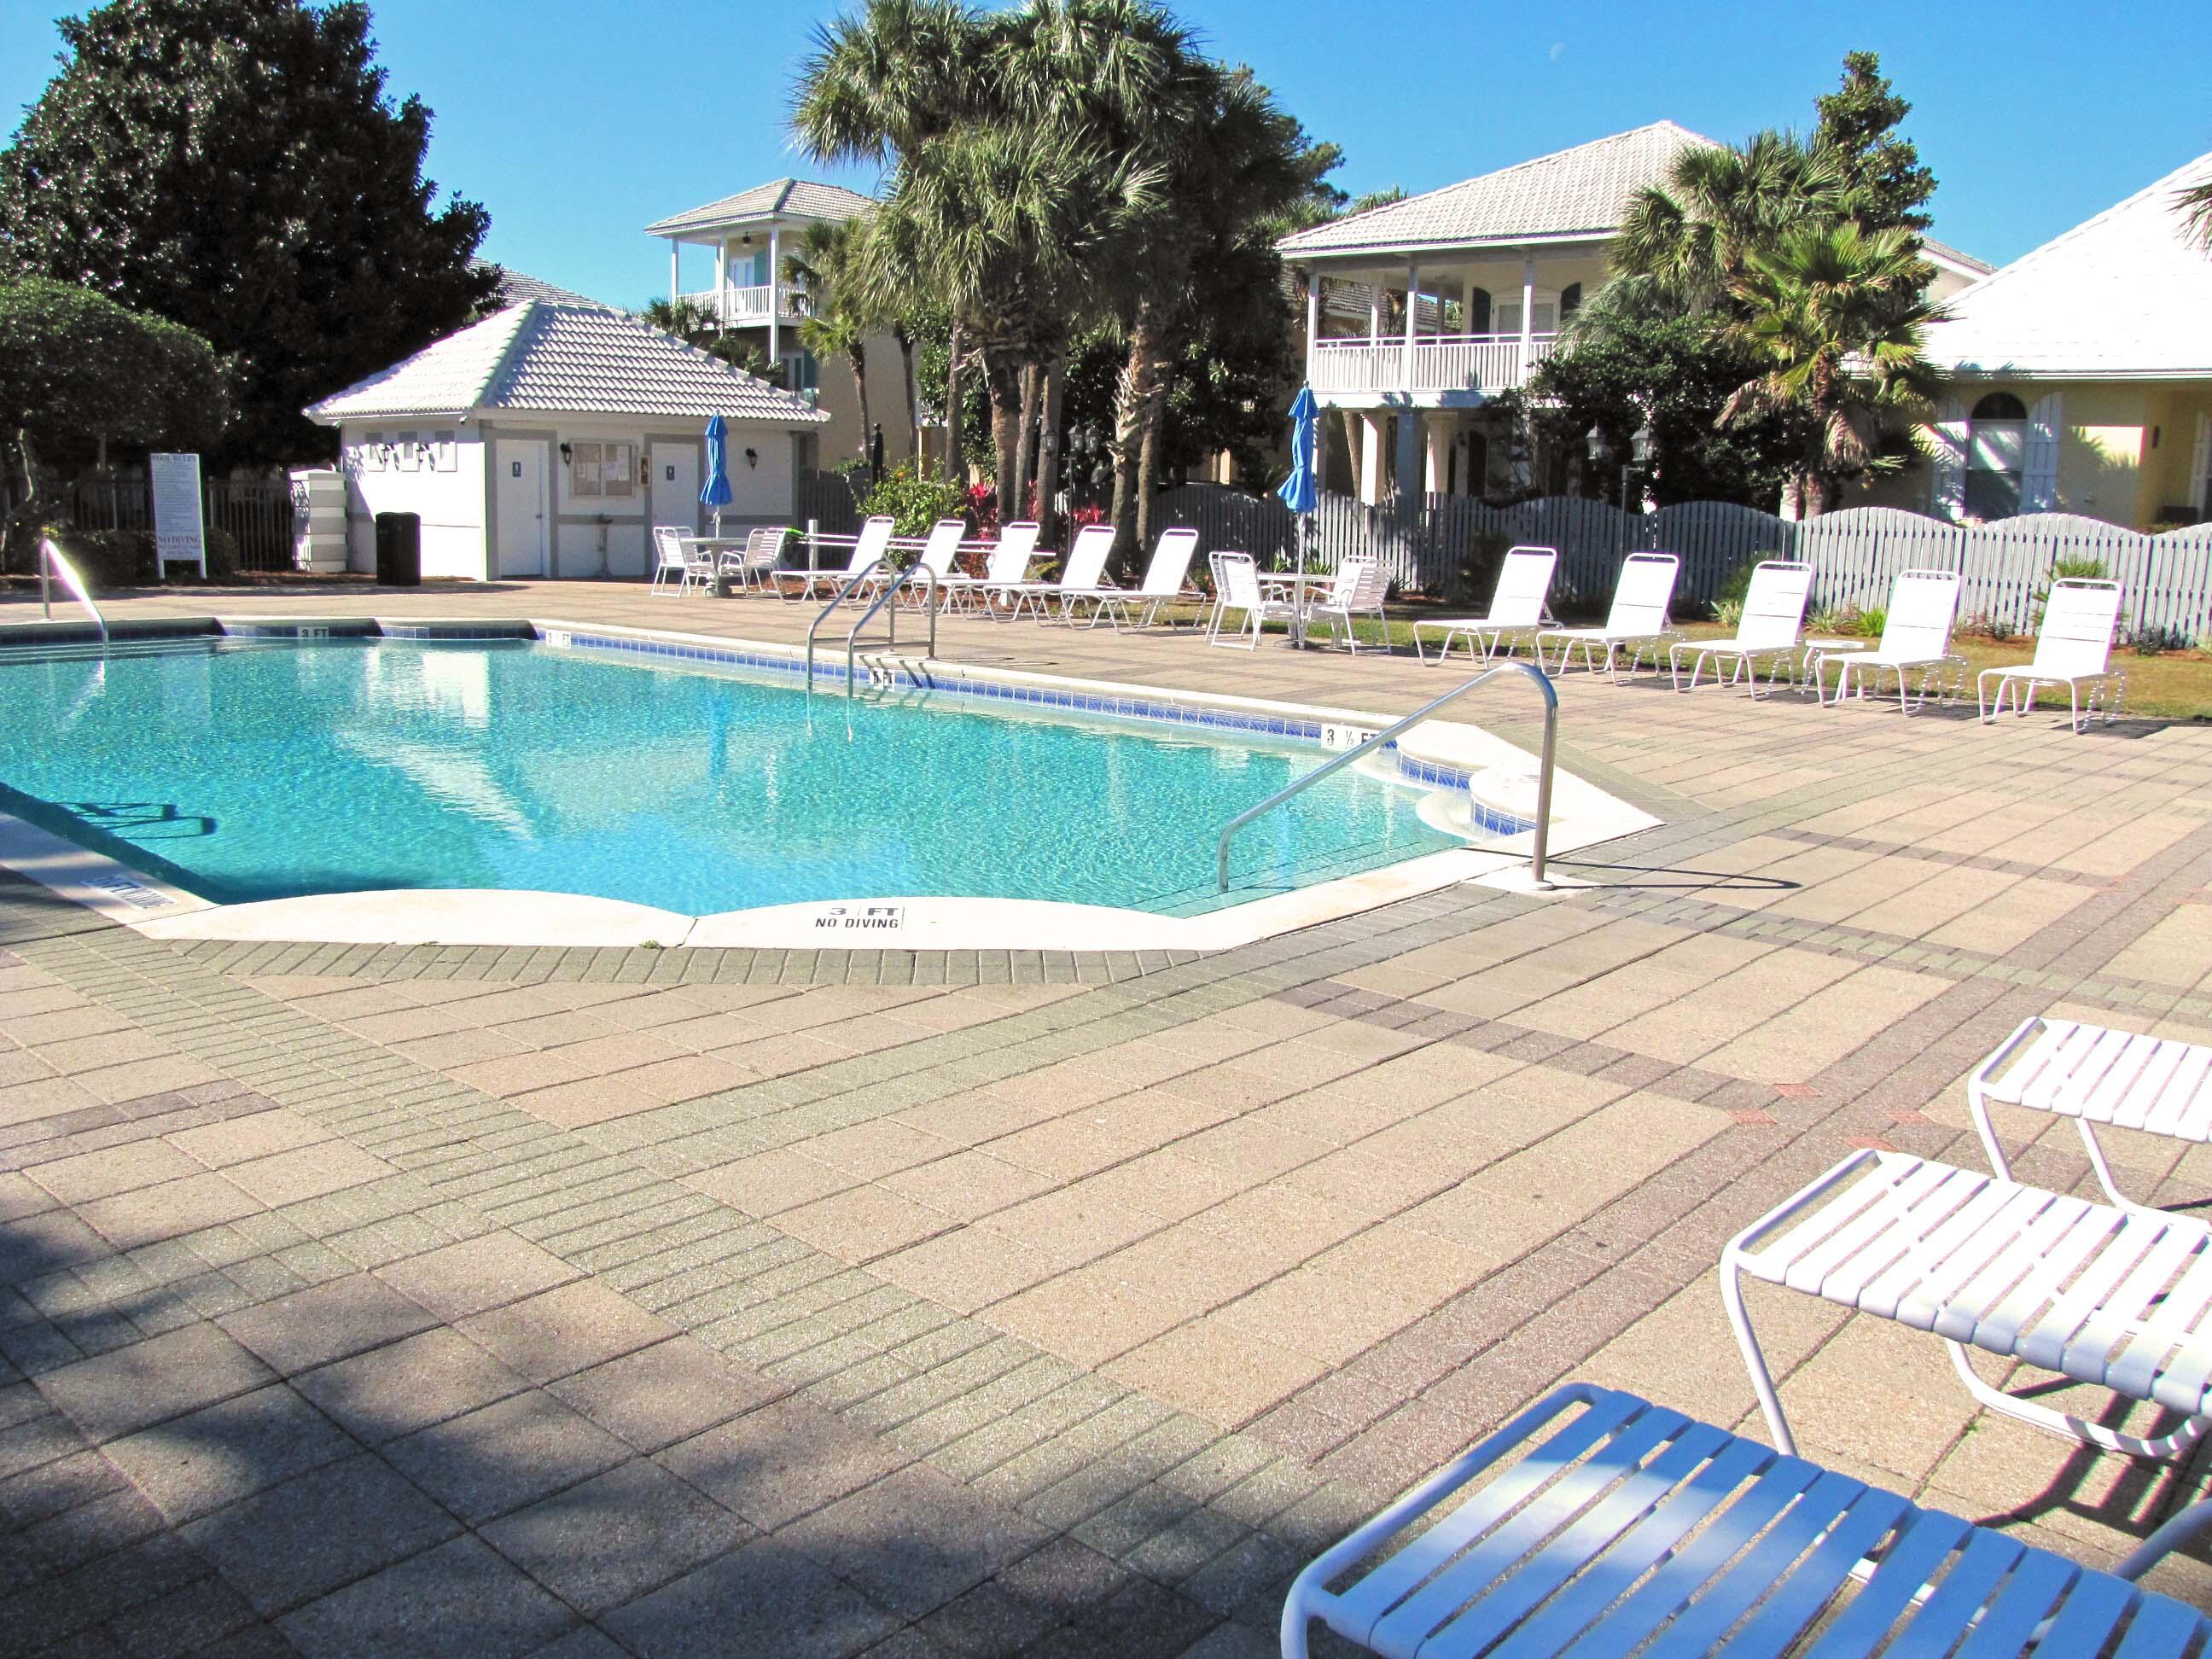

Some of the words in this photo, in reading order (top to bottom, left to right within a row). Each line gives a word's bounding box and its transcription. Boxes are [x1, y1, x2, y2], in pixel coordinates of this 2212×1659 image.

[158, 535, 171, 544] NO
[172, 535, 201, 544] DIVING
[314, 628, 329, 637] FT
[1327, 729, 1335, 745] 3
[829, 907, 847, 916] 3
[867, 907, 899, 916] FT
[815, 917, 837, 928] NO
[845, 918, 899, 928] DIVING
